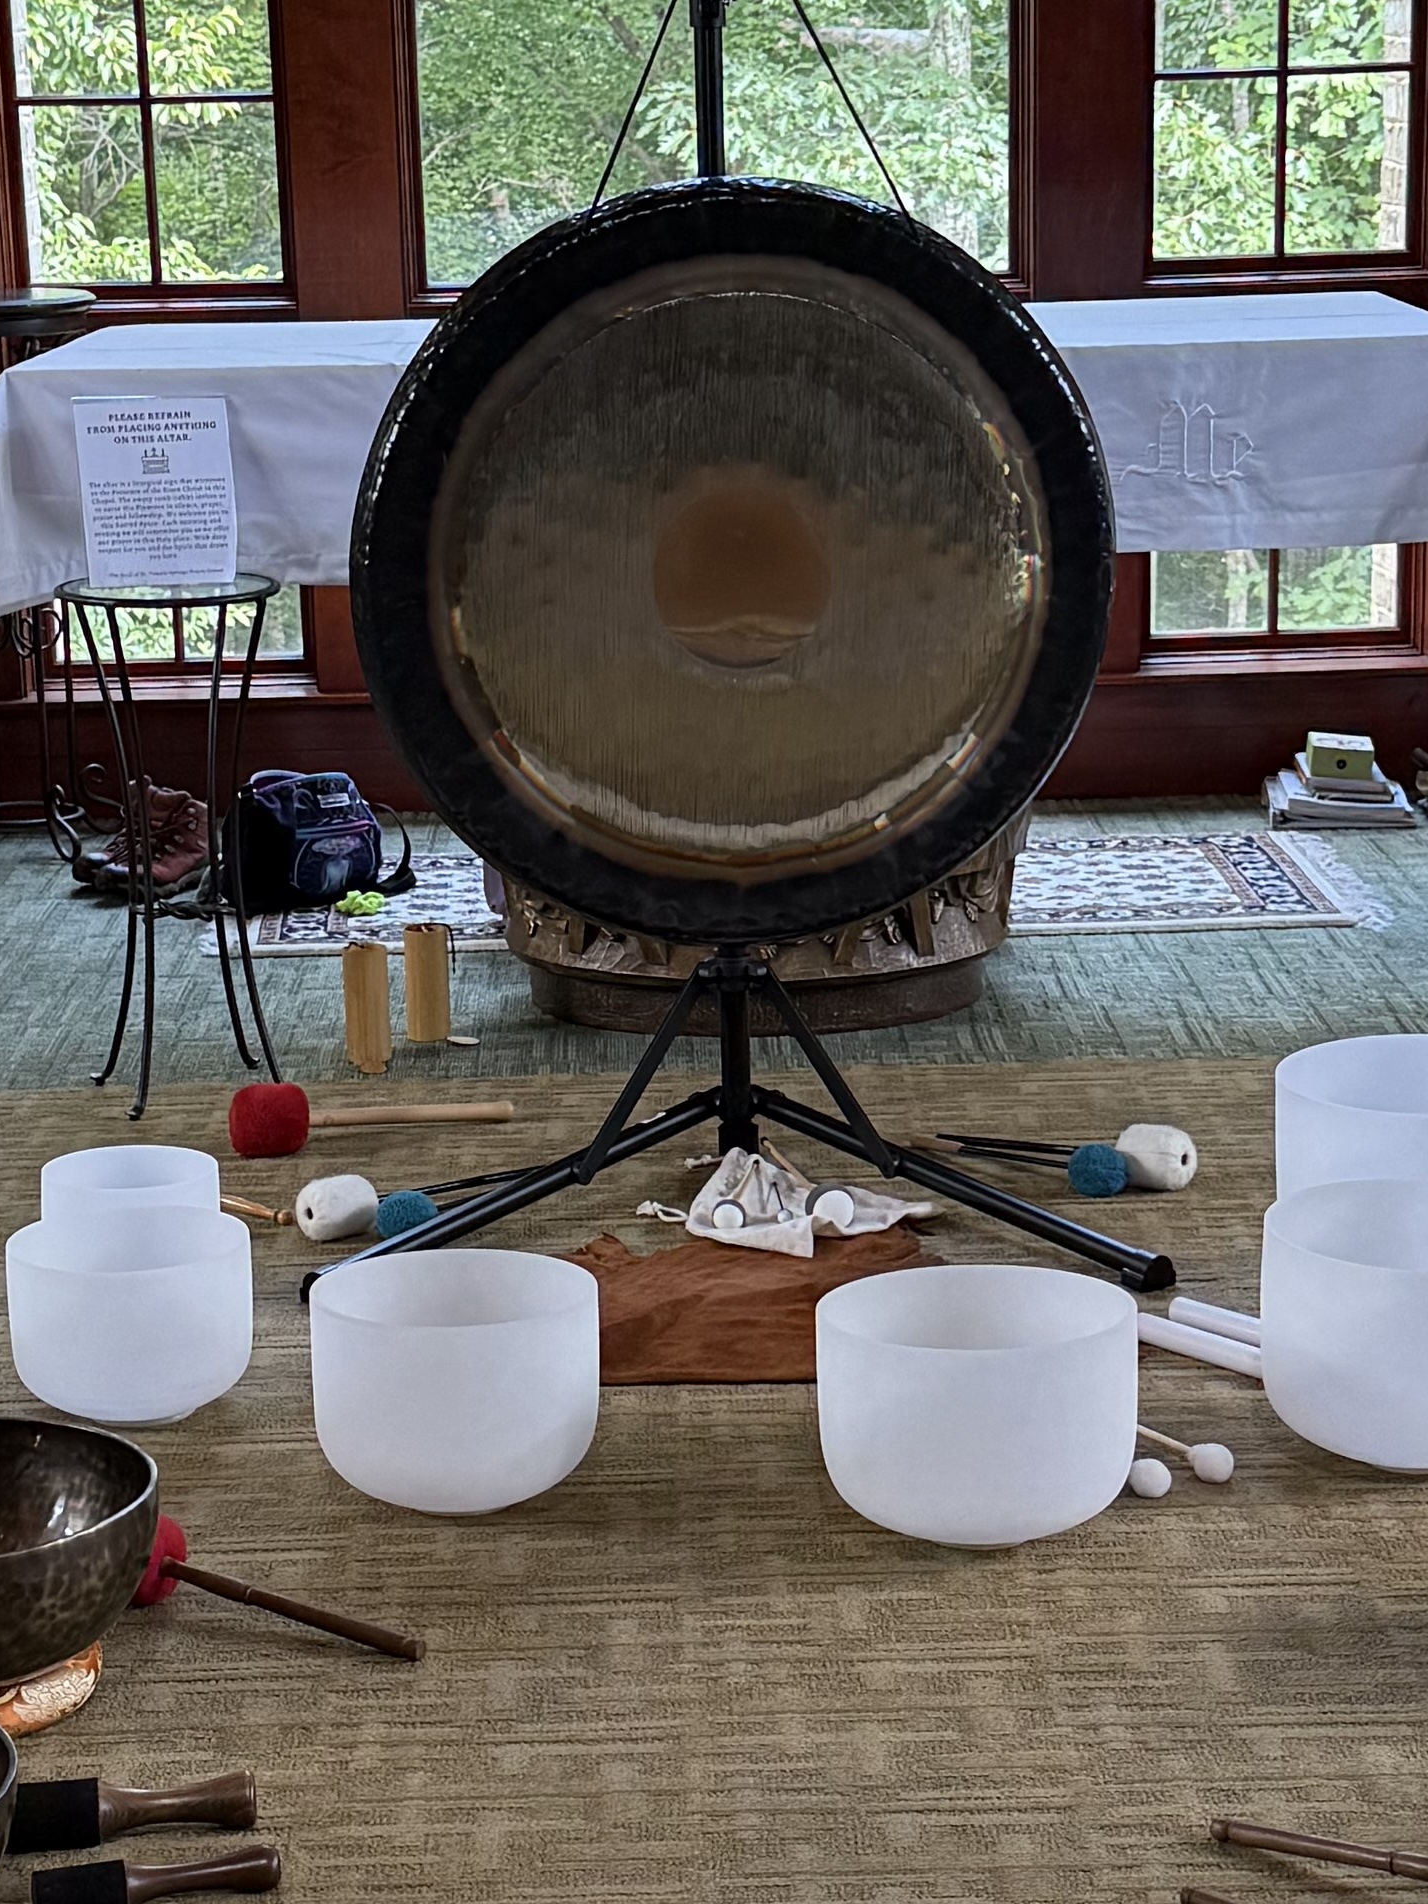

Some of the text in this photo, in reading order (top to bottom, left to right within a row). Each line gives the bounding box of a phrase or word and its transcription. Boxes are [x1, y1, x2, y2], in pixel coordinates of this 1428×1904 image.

[108, 410, 191, 422] PLEASE REFRAIN
[86, 420, 217, 435] FROM PLACING ANYTHING
[113, 433, 192, 444] ON THIS ALTAR.
